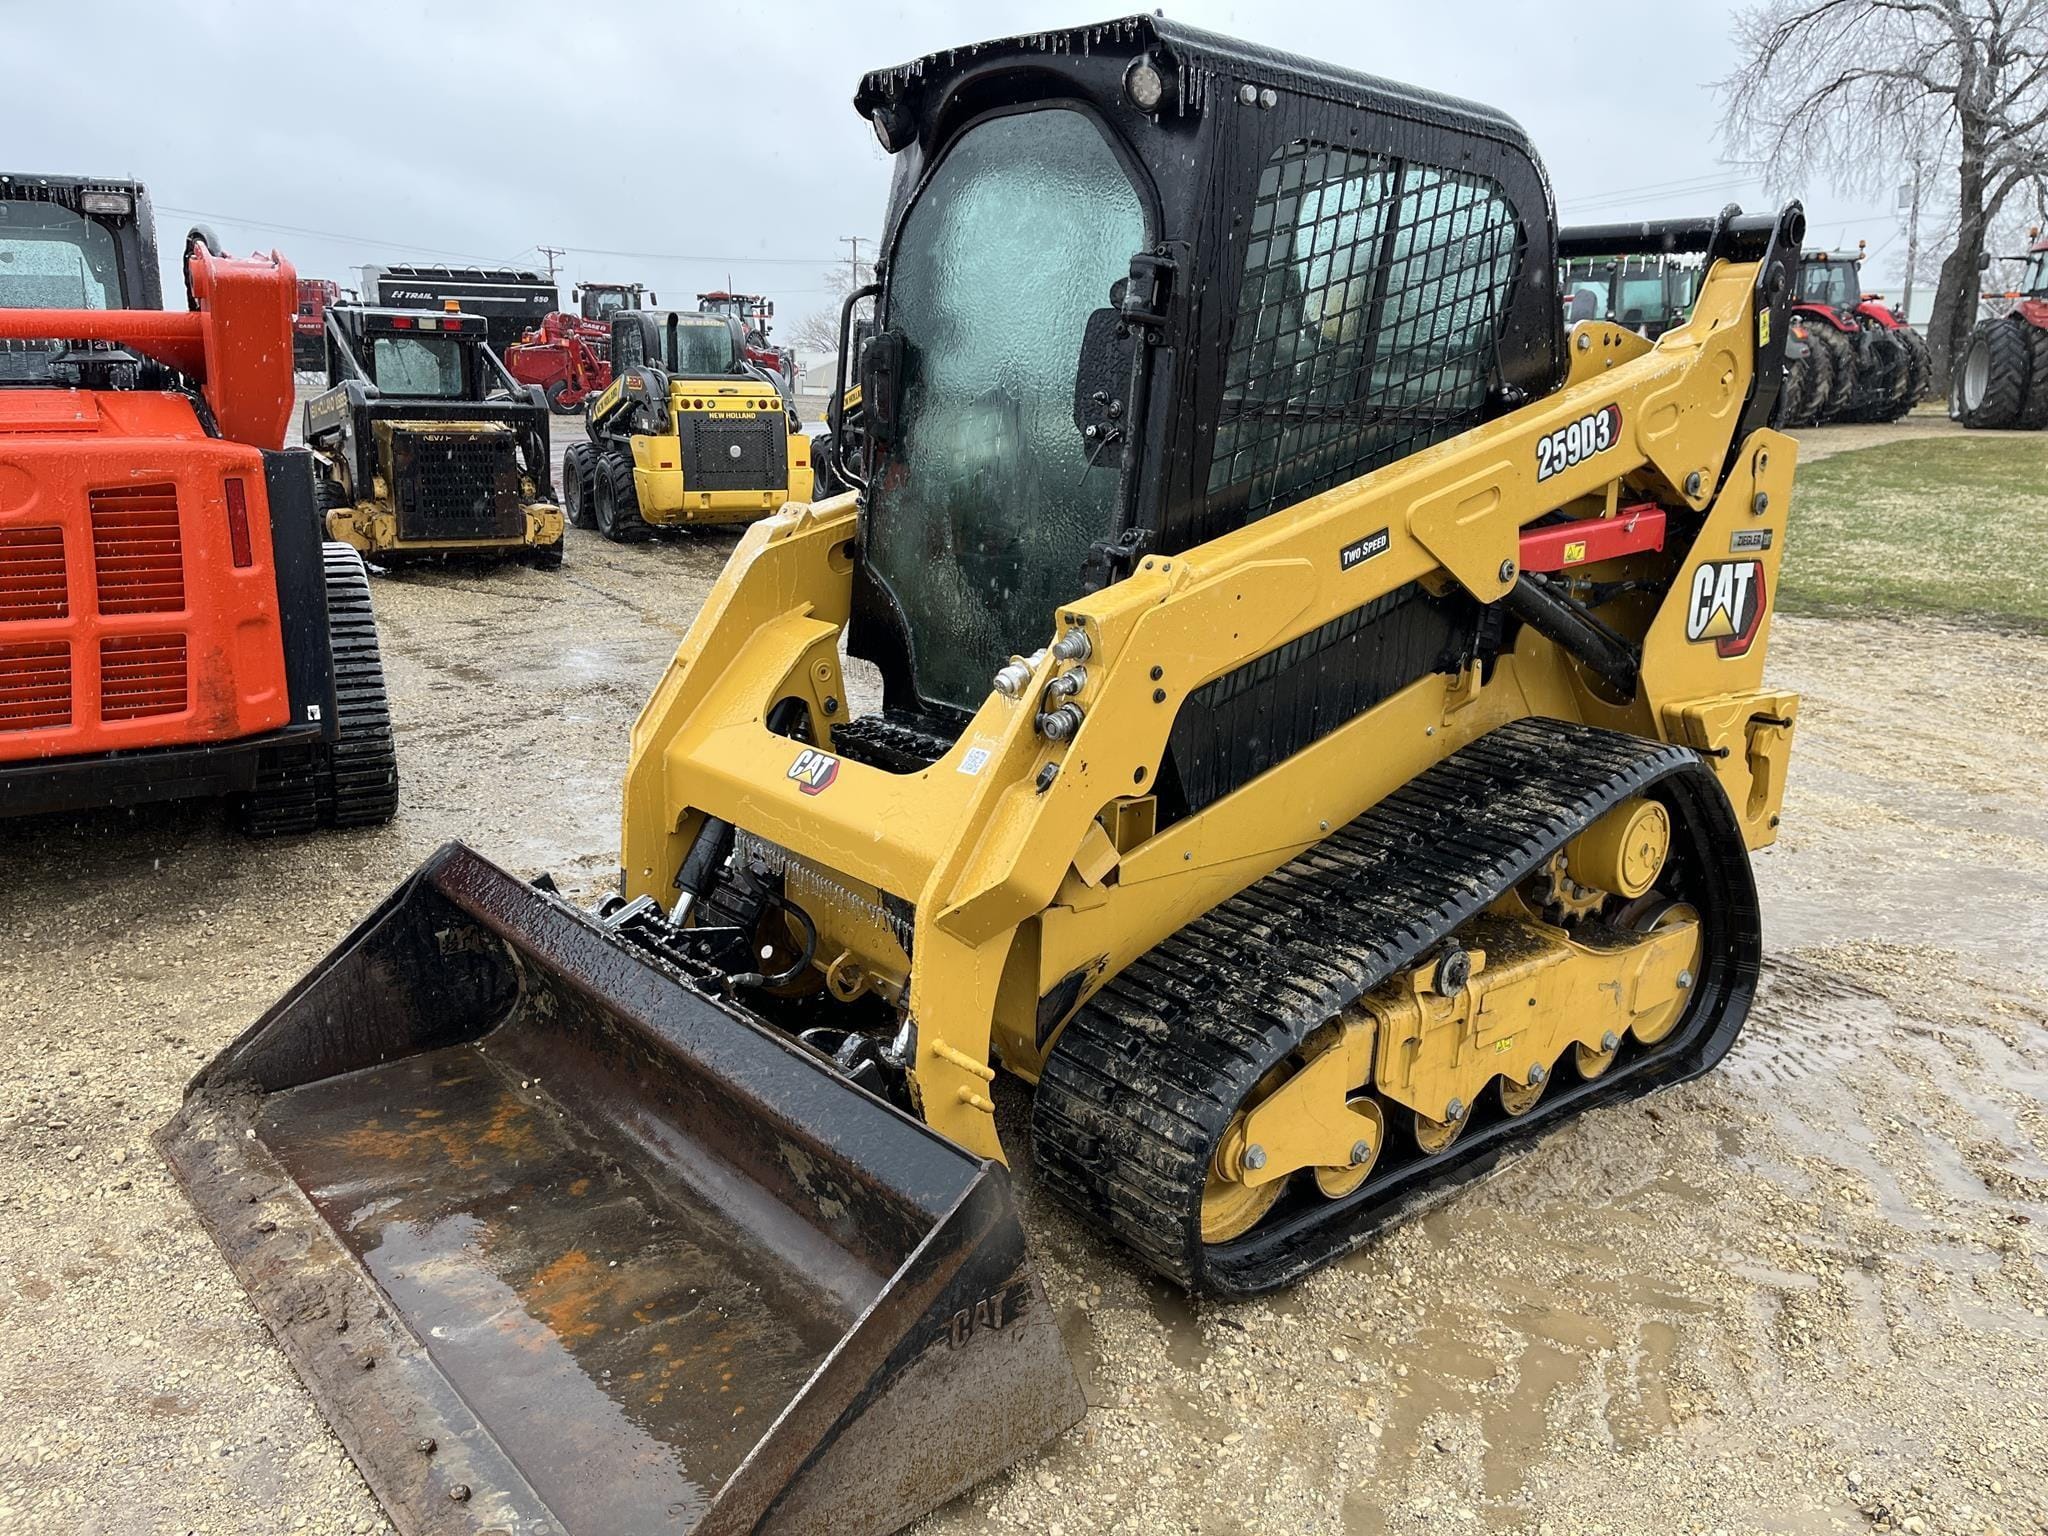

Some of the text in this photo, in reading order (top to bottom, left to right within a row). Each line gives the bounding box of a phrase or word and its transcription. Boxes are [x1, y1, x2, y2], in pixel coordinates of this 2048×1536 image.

[405, 291, 433, 300] TRAIL
[582, 322, 600, 330] CASE
[1537, 409, 1610, 480] 259D3
[1343, 535, 1387, 565] TWO SPEED
[1737, 534, 1761, 546] ZIEGLER
[1687, 562, 1755, 640] CAT
[788, 749, 837, 786] CAT
[951, 1289, 1008, 1351] CAT
